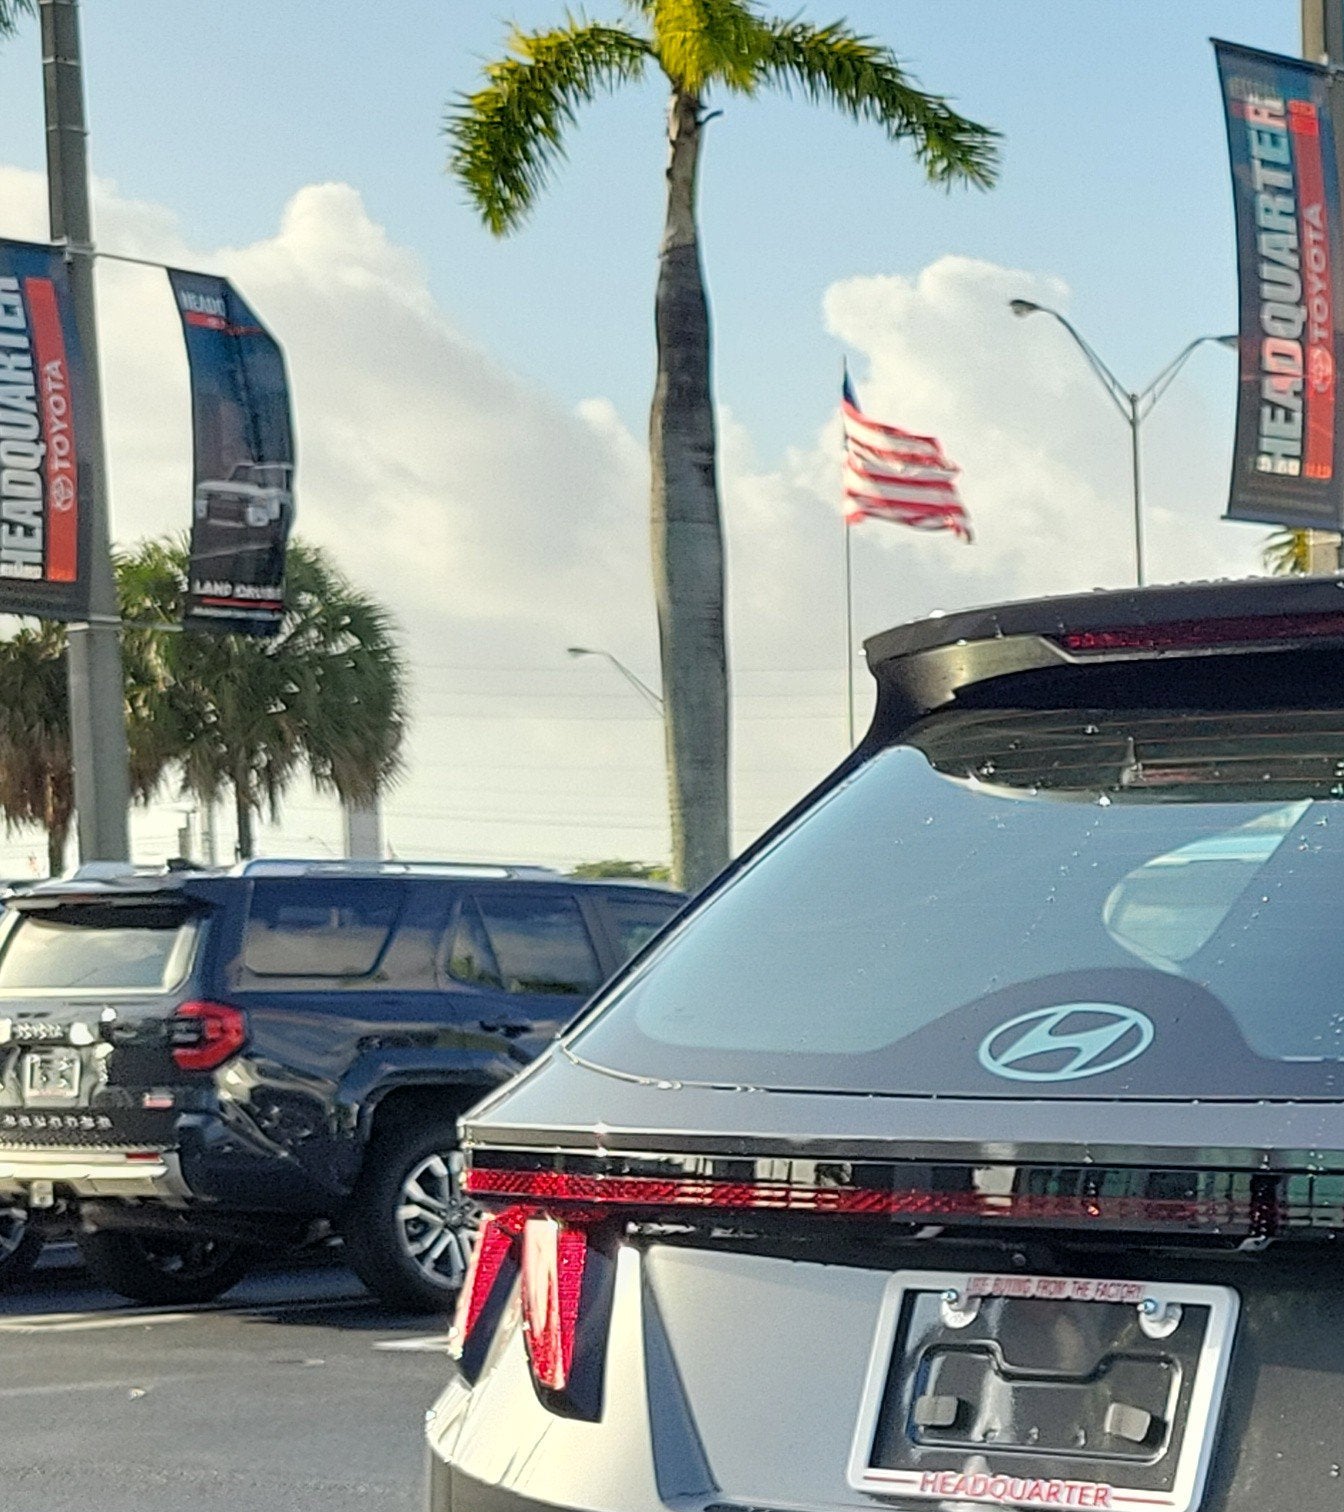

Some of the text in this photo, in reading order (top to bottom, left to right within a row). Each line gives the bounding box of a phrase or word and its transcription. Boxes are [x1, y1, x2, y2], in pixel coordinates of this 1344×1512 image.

[1245, 95, 1307, 476] HEADQUARTER
[1304, 203, 1330, 344] TOYOTA
[44, 360, 72, 470] TOYOTA
[919, 1471, 1112, 1508] HEADQUARTER
